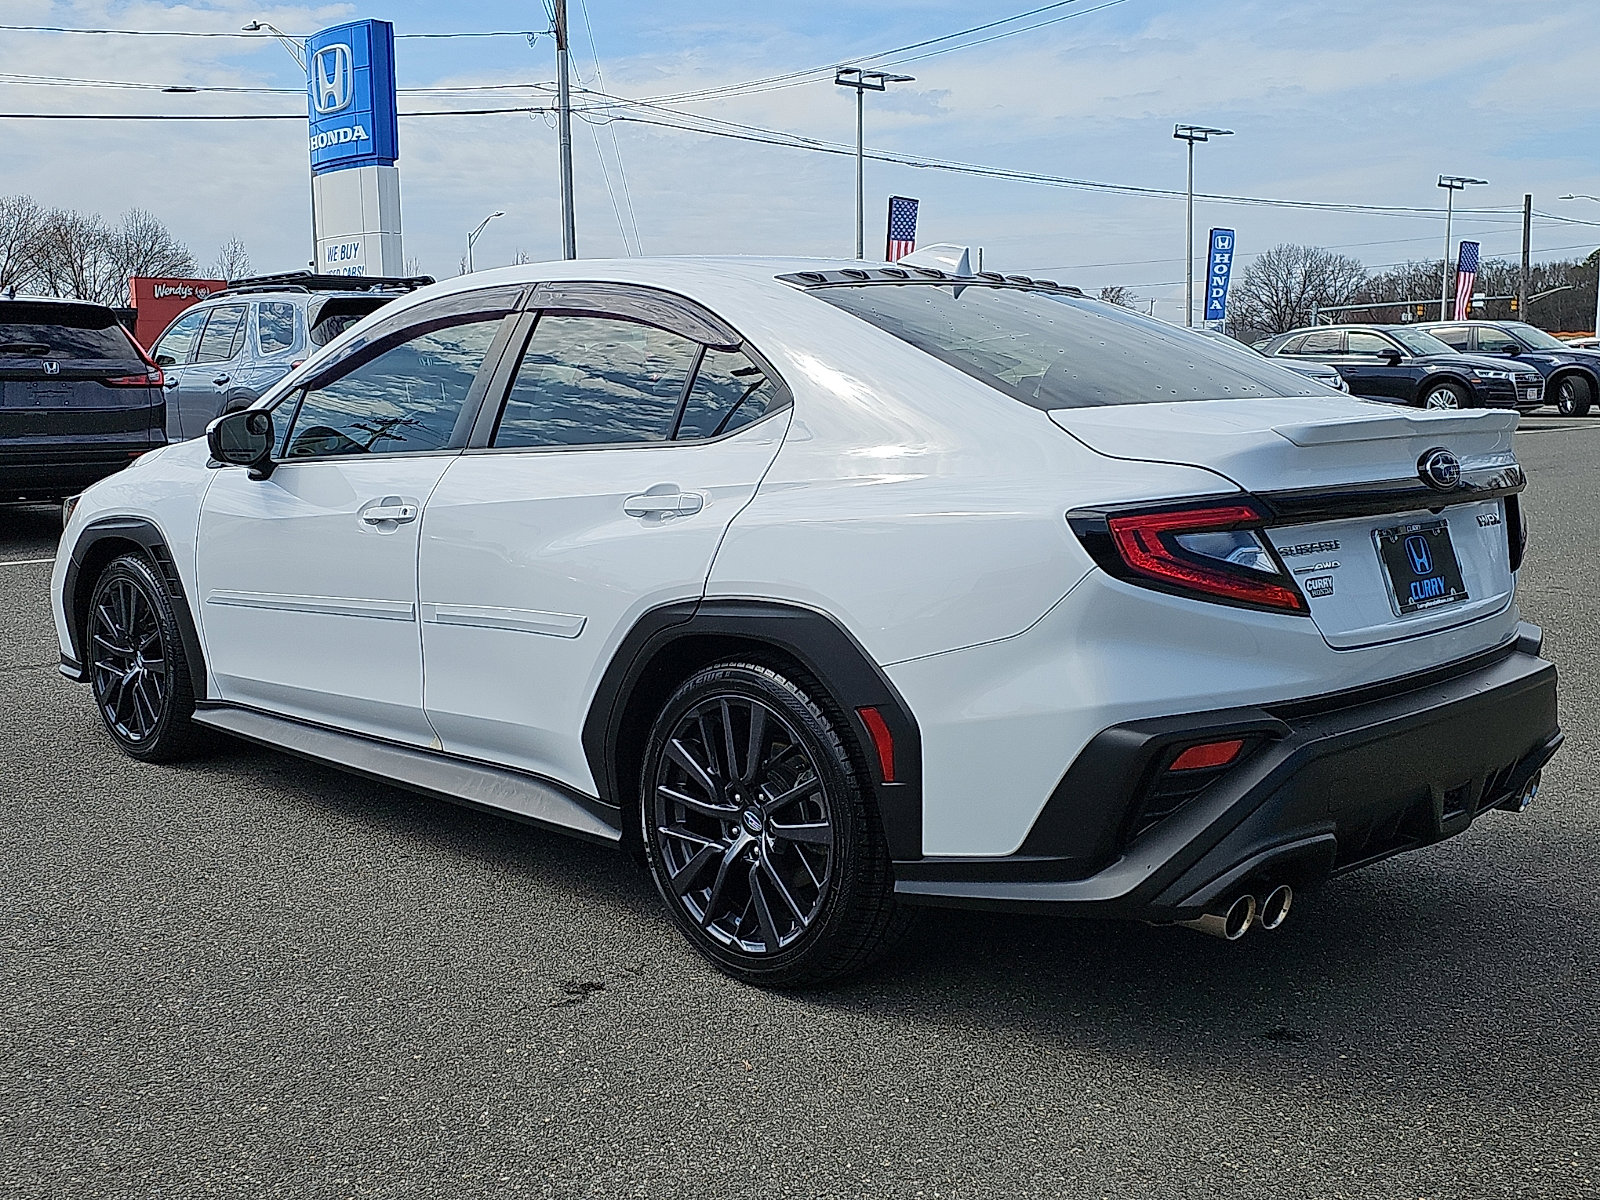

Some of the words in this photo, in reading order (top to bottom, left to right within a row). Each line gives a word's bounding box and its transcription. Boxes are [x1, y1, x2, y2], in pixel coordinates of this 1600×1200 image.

[309, 125, 370, 152] HONDA
[327, 245, 339, 263] WE
[340, 242, 360, 261] BUY
[153, 282, 194, 300] Wendy's
[1209, 253, 1231, 310] HONDA
[1313, 560, 1341, 572] AWD
[1306, 577, 1333, 591] CURRY
[1311, 588, 1333, 597] HONDA
[1410, 576, 1446, 601] CURRY
